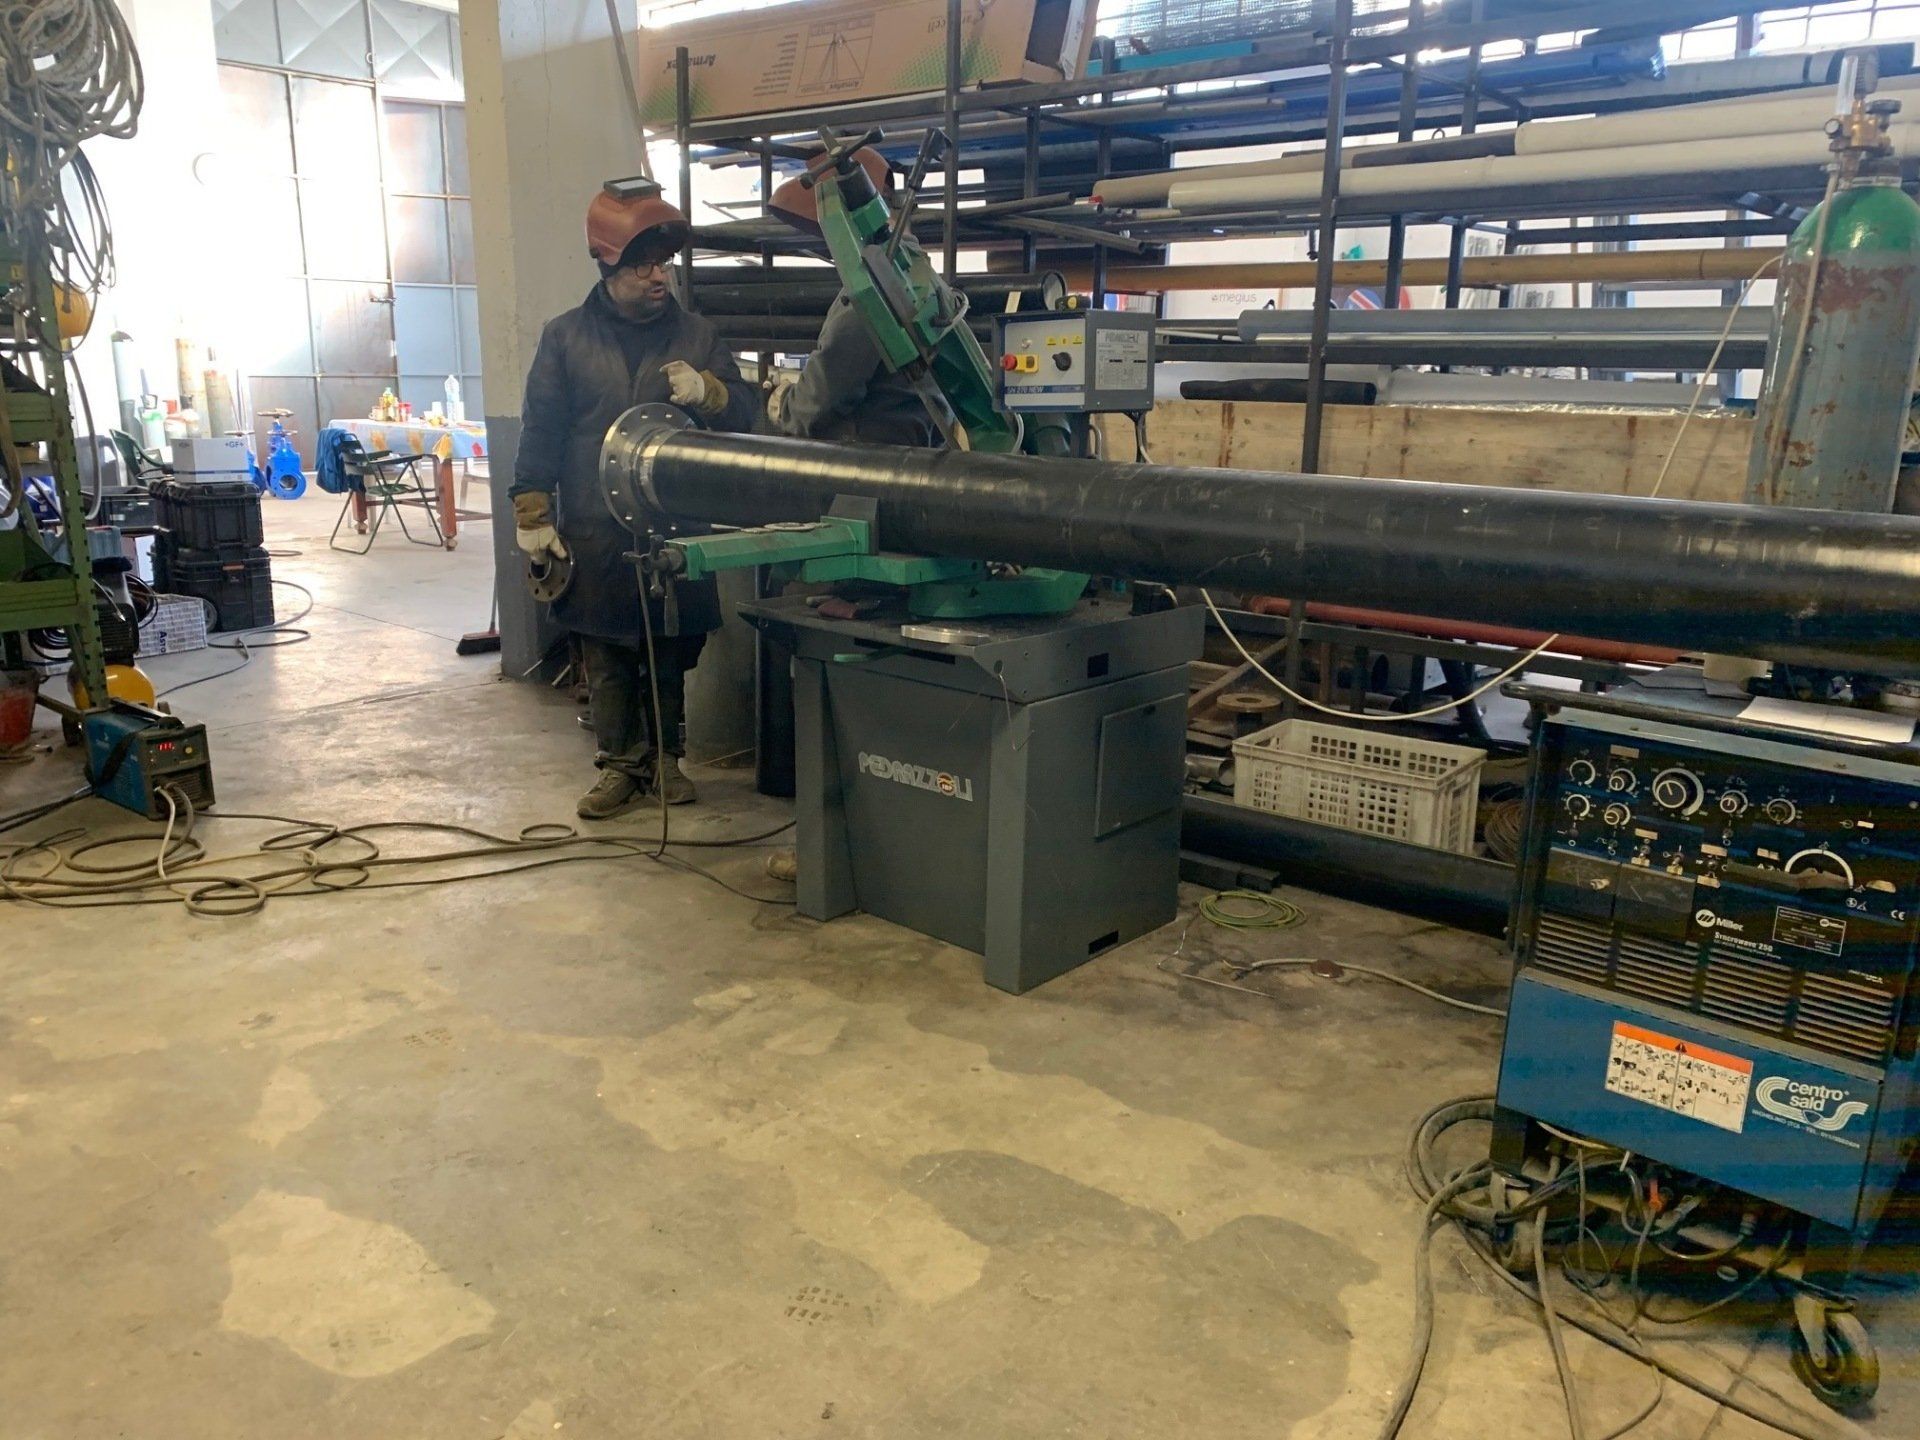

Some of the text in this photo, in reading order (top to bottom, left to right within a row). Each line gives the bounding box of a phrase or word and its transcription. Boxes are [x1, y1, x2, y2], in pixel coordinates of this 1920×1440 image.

[663, 54, 717, 74] Armaex
[1758, 943, 1773, 952] 250
[1788, 1081, 1843, 1101] centro
[1789, 1095, 1825, 1111] sald
